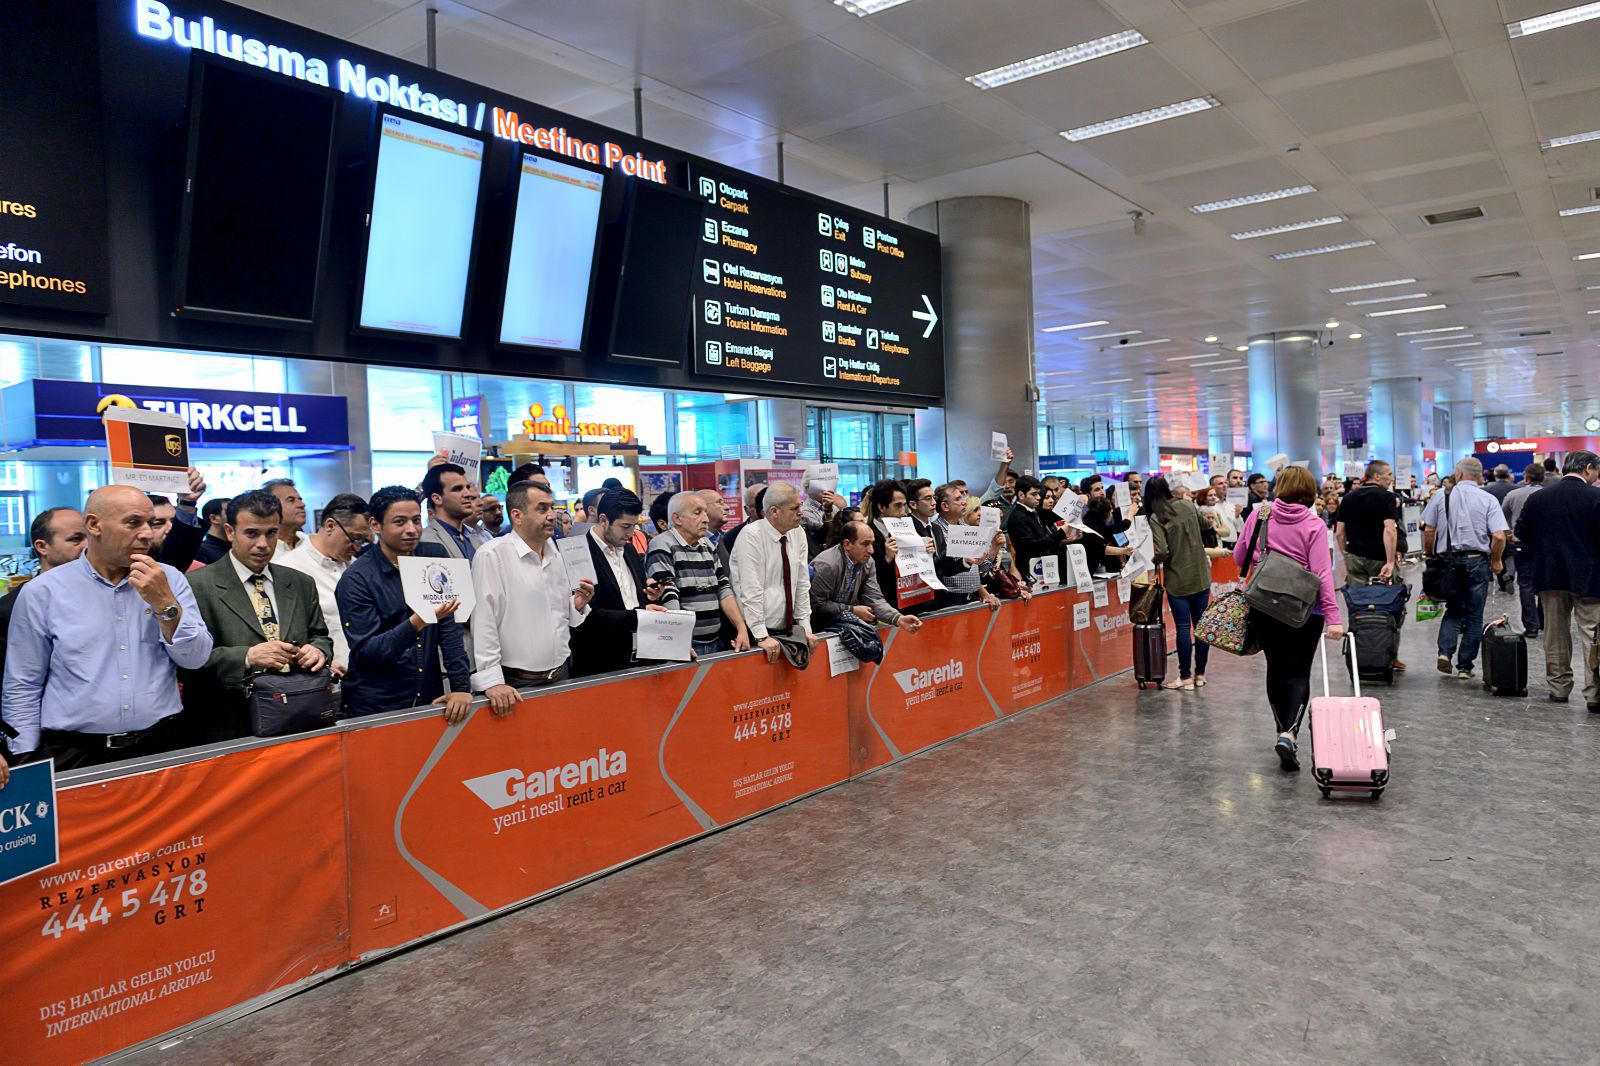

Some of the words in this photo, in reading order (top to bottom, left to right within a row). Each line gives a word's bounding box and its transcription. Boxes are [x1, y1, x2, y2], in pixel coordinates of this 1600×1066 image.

[605, 141, 667, 184] Point
[719, 182, 749, 200] Otopark
[0, 200, 37, 218] res
[720, 197, 749, 214] Carpark
[721, 221, 749, 238] Eczane
[722, 234, 758, 254] Pharmacy
[877, 243, 890, 255] Post
[723, 262, 739, 276] Otel
[850, 269, 872, 284] Subway
[0, 270, 87, 294] ephones
[723, 277, 743, 291] Hotel
[743, 279, 787, 299] Reservations
[724, 302, 750, 316] Turizm
[837, 301, 850, 312] Rent
[856, 303, 868, 315] Car
[725, 317, 750, 331] Tourist
[750, 320, 788, 336] Information
[838, 335, 856, 347] Banks
[881, 342, 909, 356] Telephones
[725, 342, 753, 356] Emanet
[754, 345, 774, 361] Bagaj
[725, 356, 740, 368] Left
[741, 357, 772, 373] Baggage
[839, 370, 872, 383] International
[872, 373, 900, 386] Departures
[898, 659, 963, 693] Garenta
[734, 703, 791, 723] REZERVASYON
[734, 722, 757, 742] 444
[760, 719, 768, 735] 5
[770, 712, 792, 731] 478
[486, 748, 627, 809] Garenta
[493, 804, 528, 835] yeni
[529, 794, 564, 819] nesil
[566, 786, 594, 808] rent
[597, 787, 605, 799] a
[607, 780, 628, 796] car
[5, 834, 37, 851] cruising
[39, 834, 204, 889] www.garenta.com.tr
[40, 852, 207, 910] REZERVASYON
[41, 897, 112, 939] 444
[121, 888, 140, 918] 5
[150, 868, 208, 907] 478
[154, 898, 205, 925] GRT
[39, 1001, 66, 1021] DIŞ
[69, 980, 128, 1011] HATLAR
[130, 964, 173, 989] GELEN
[174, 949, 216, 974] YOLCU
[45, 989, 157, 1039] INTERNATIONAL
[158, 969, 213, 998] ARRIVAL
